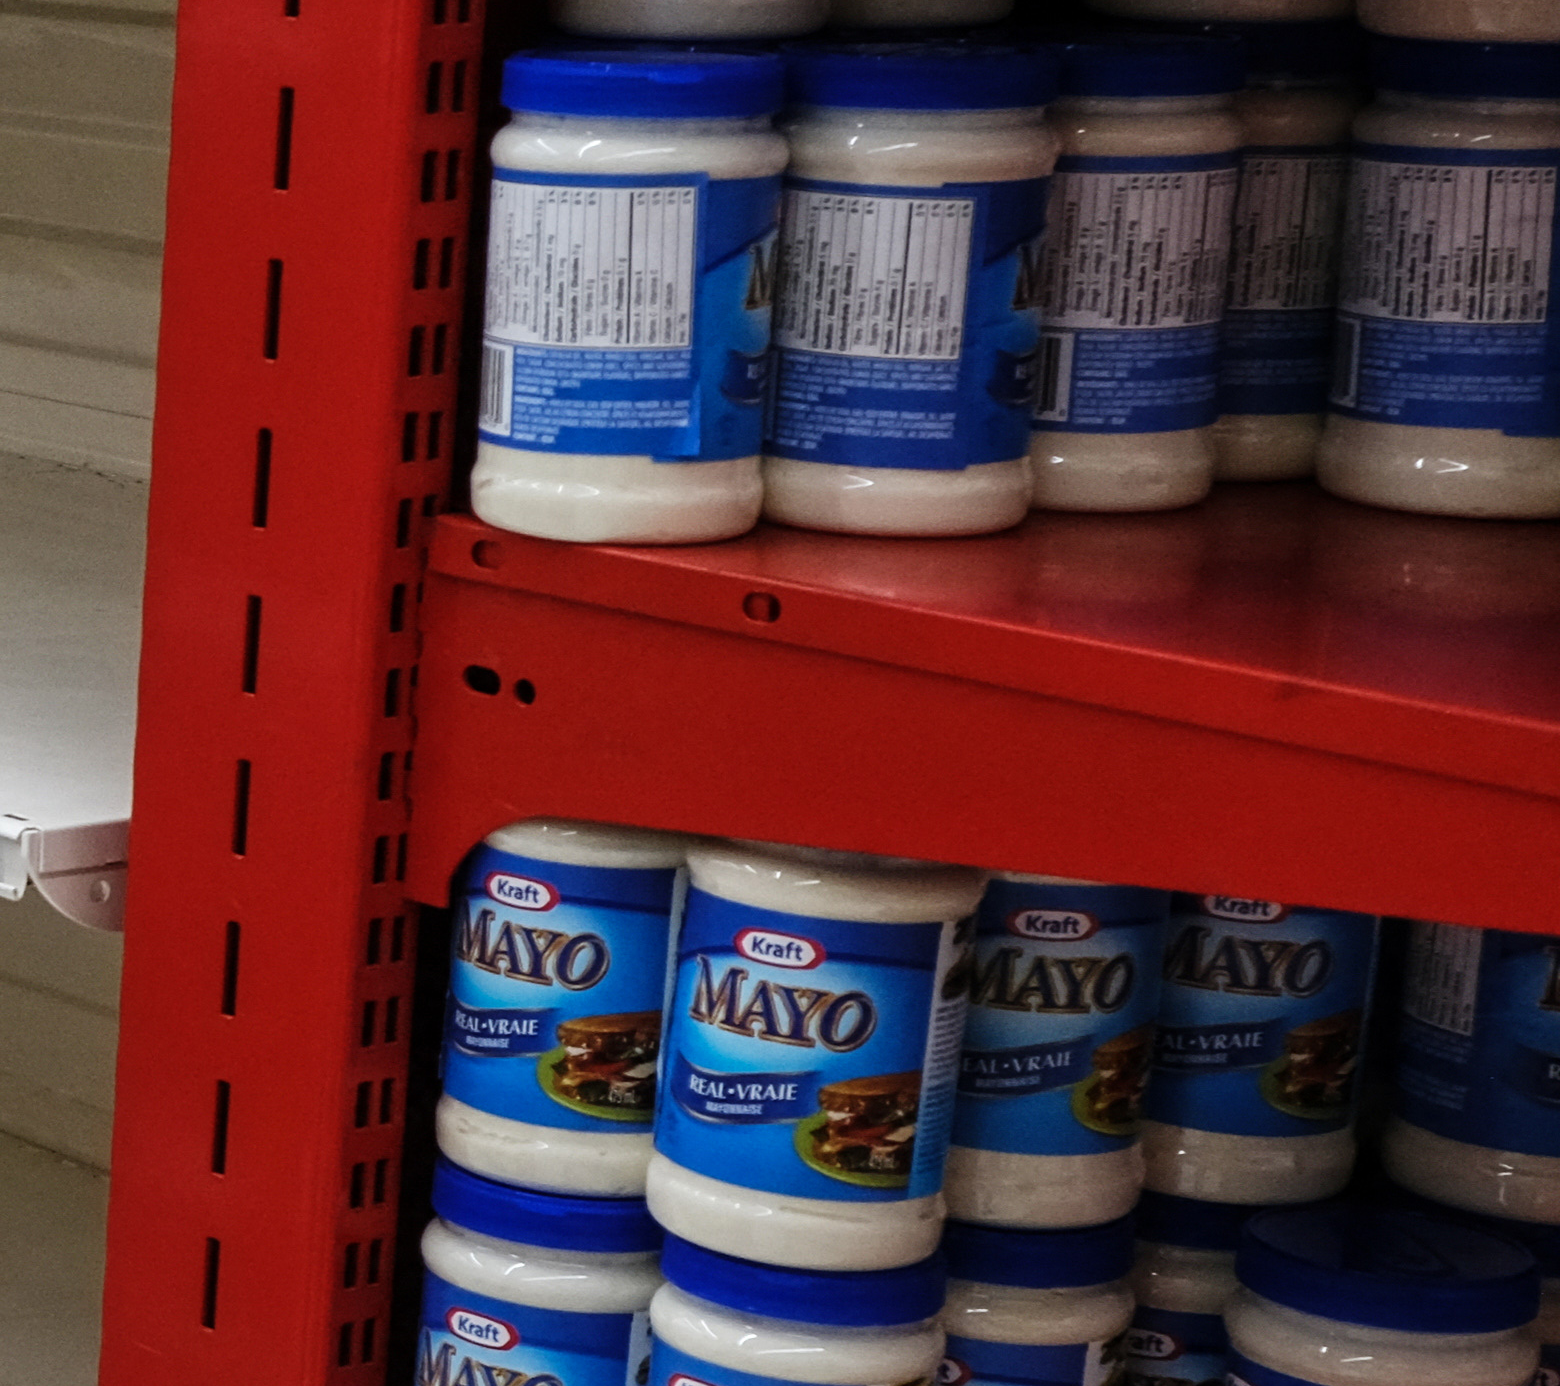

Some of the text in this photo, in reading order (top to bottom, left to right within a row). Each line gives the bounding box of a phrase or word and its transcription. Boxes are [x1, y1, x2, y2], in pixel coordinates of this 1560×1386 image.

[496, 879, 540, 905] Kraft
[1214, 895, 1271, 917] Kraft
[1024, 915, 1081, 936] Kraft
[456, 898, 611, 992] MAYO
[750, 937, 804, 964] Kraft
[1162, 925, 1333, 998] MAYO
[970, 947, 1135, 1014] MAYO
[688, 954, 879, 1054] MAYO
[488, 1017, 539, 1037] VRAIE
[1197, 1030, 1263, 1051] VRAIE
[1013, 1050, 1071, 1073] VRAIE
[688, 1074, 799, 1102] REAL VRAIE
[456, 1315, 500, 1344] Kraft
[1127, 1333, 1166, 1355] aft
